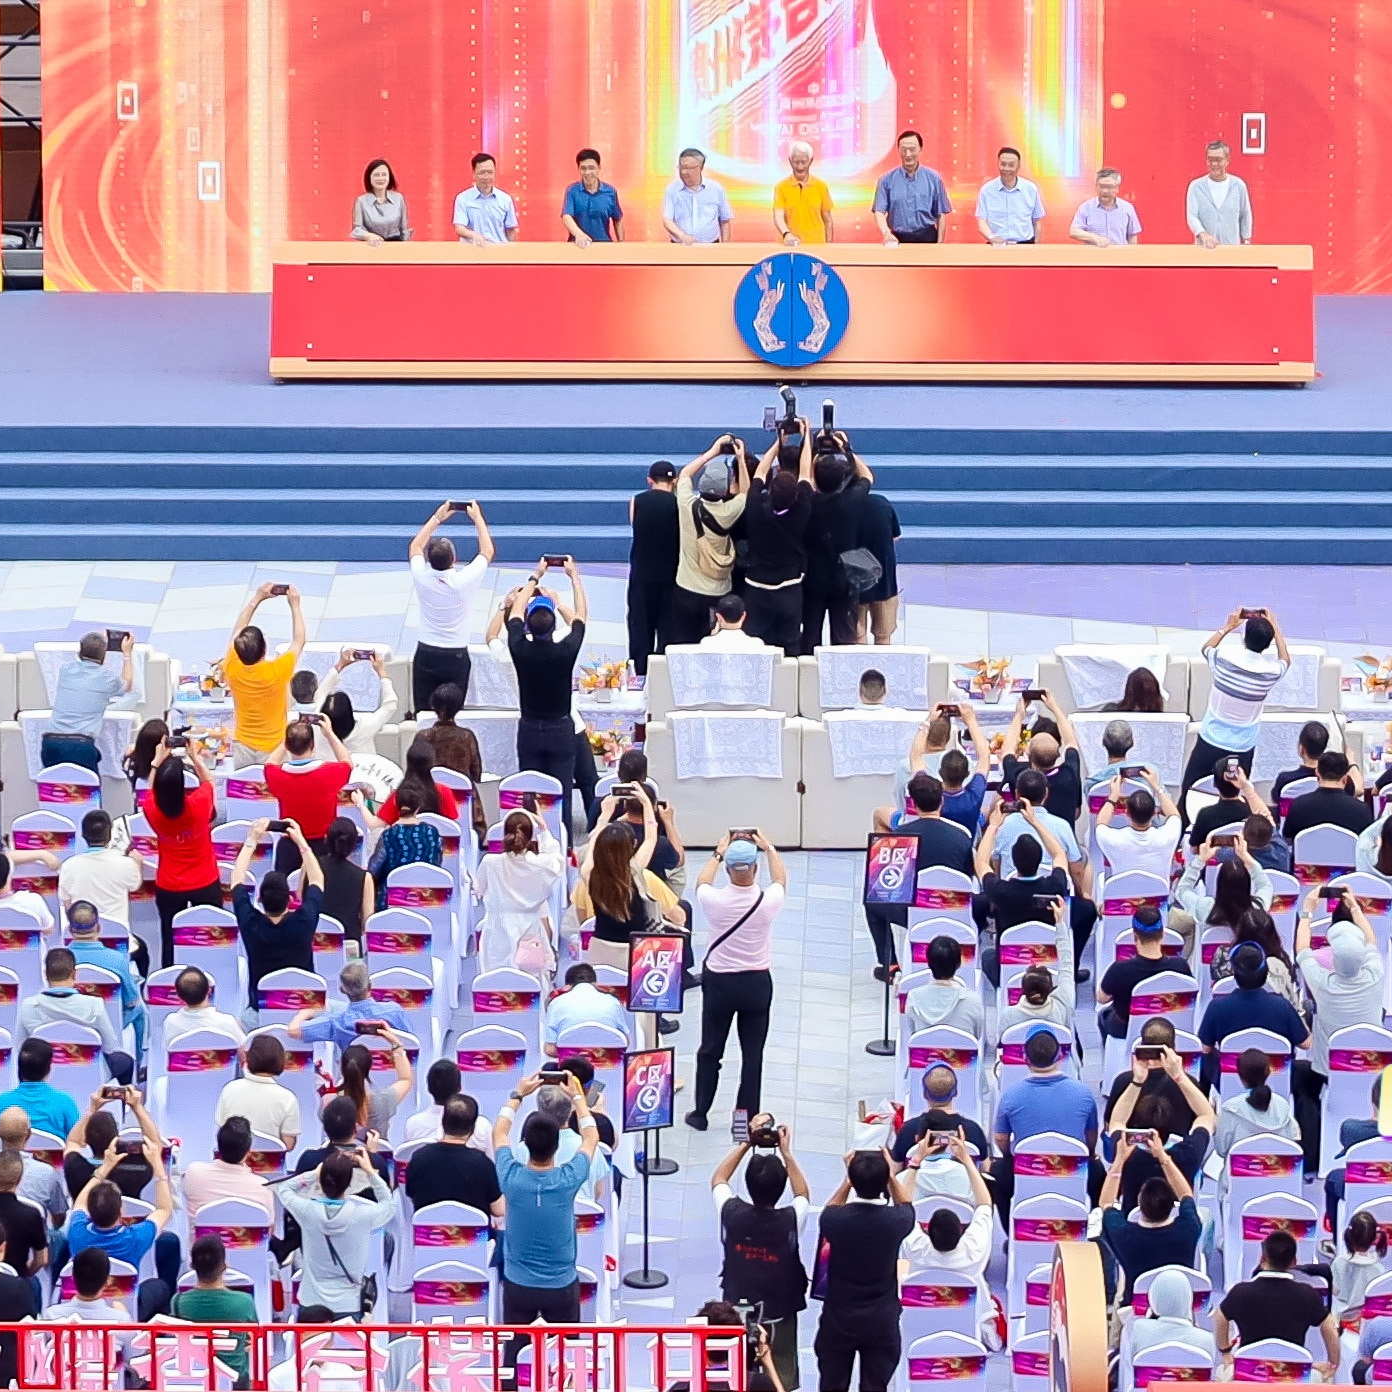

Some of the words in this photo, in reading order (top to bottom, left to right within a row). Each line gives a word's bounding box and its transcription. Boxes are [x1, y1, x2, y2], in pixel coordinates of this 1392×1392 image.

[878, 847, 908, 864] B区
[641, 950, 674, 968] A区
[635, 1064, 662, 1085] C区
